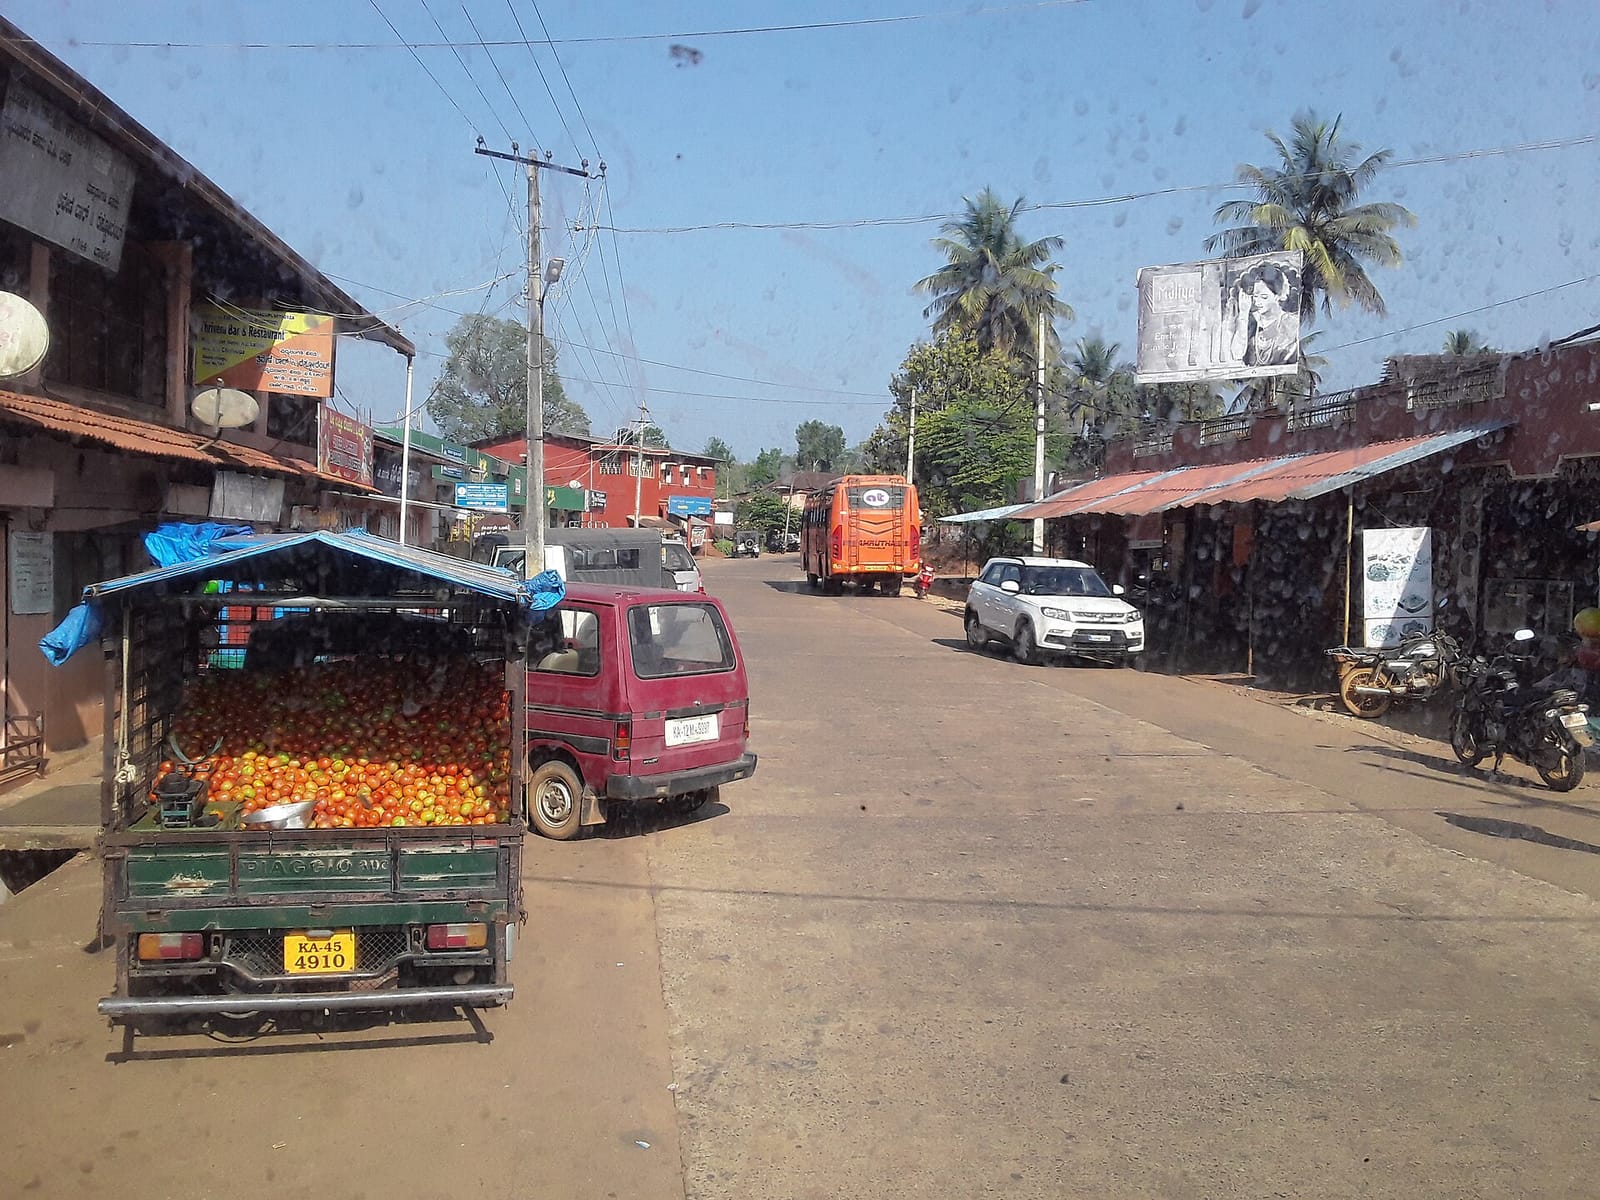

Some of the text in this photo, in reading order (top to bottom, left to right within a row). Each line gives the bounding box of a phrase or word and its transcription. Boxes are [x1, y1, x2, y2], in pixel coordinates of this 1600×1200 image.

[248, 326, 285, 340] Restaurant
[241, 858, 352, 874] PIAGGIO
[298, 941, 342, 953] KA-45
[294, 953, 345, 969] 4910
